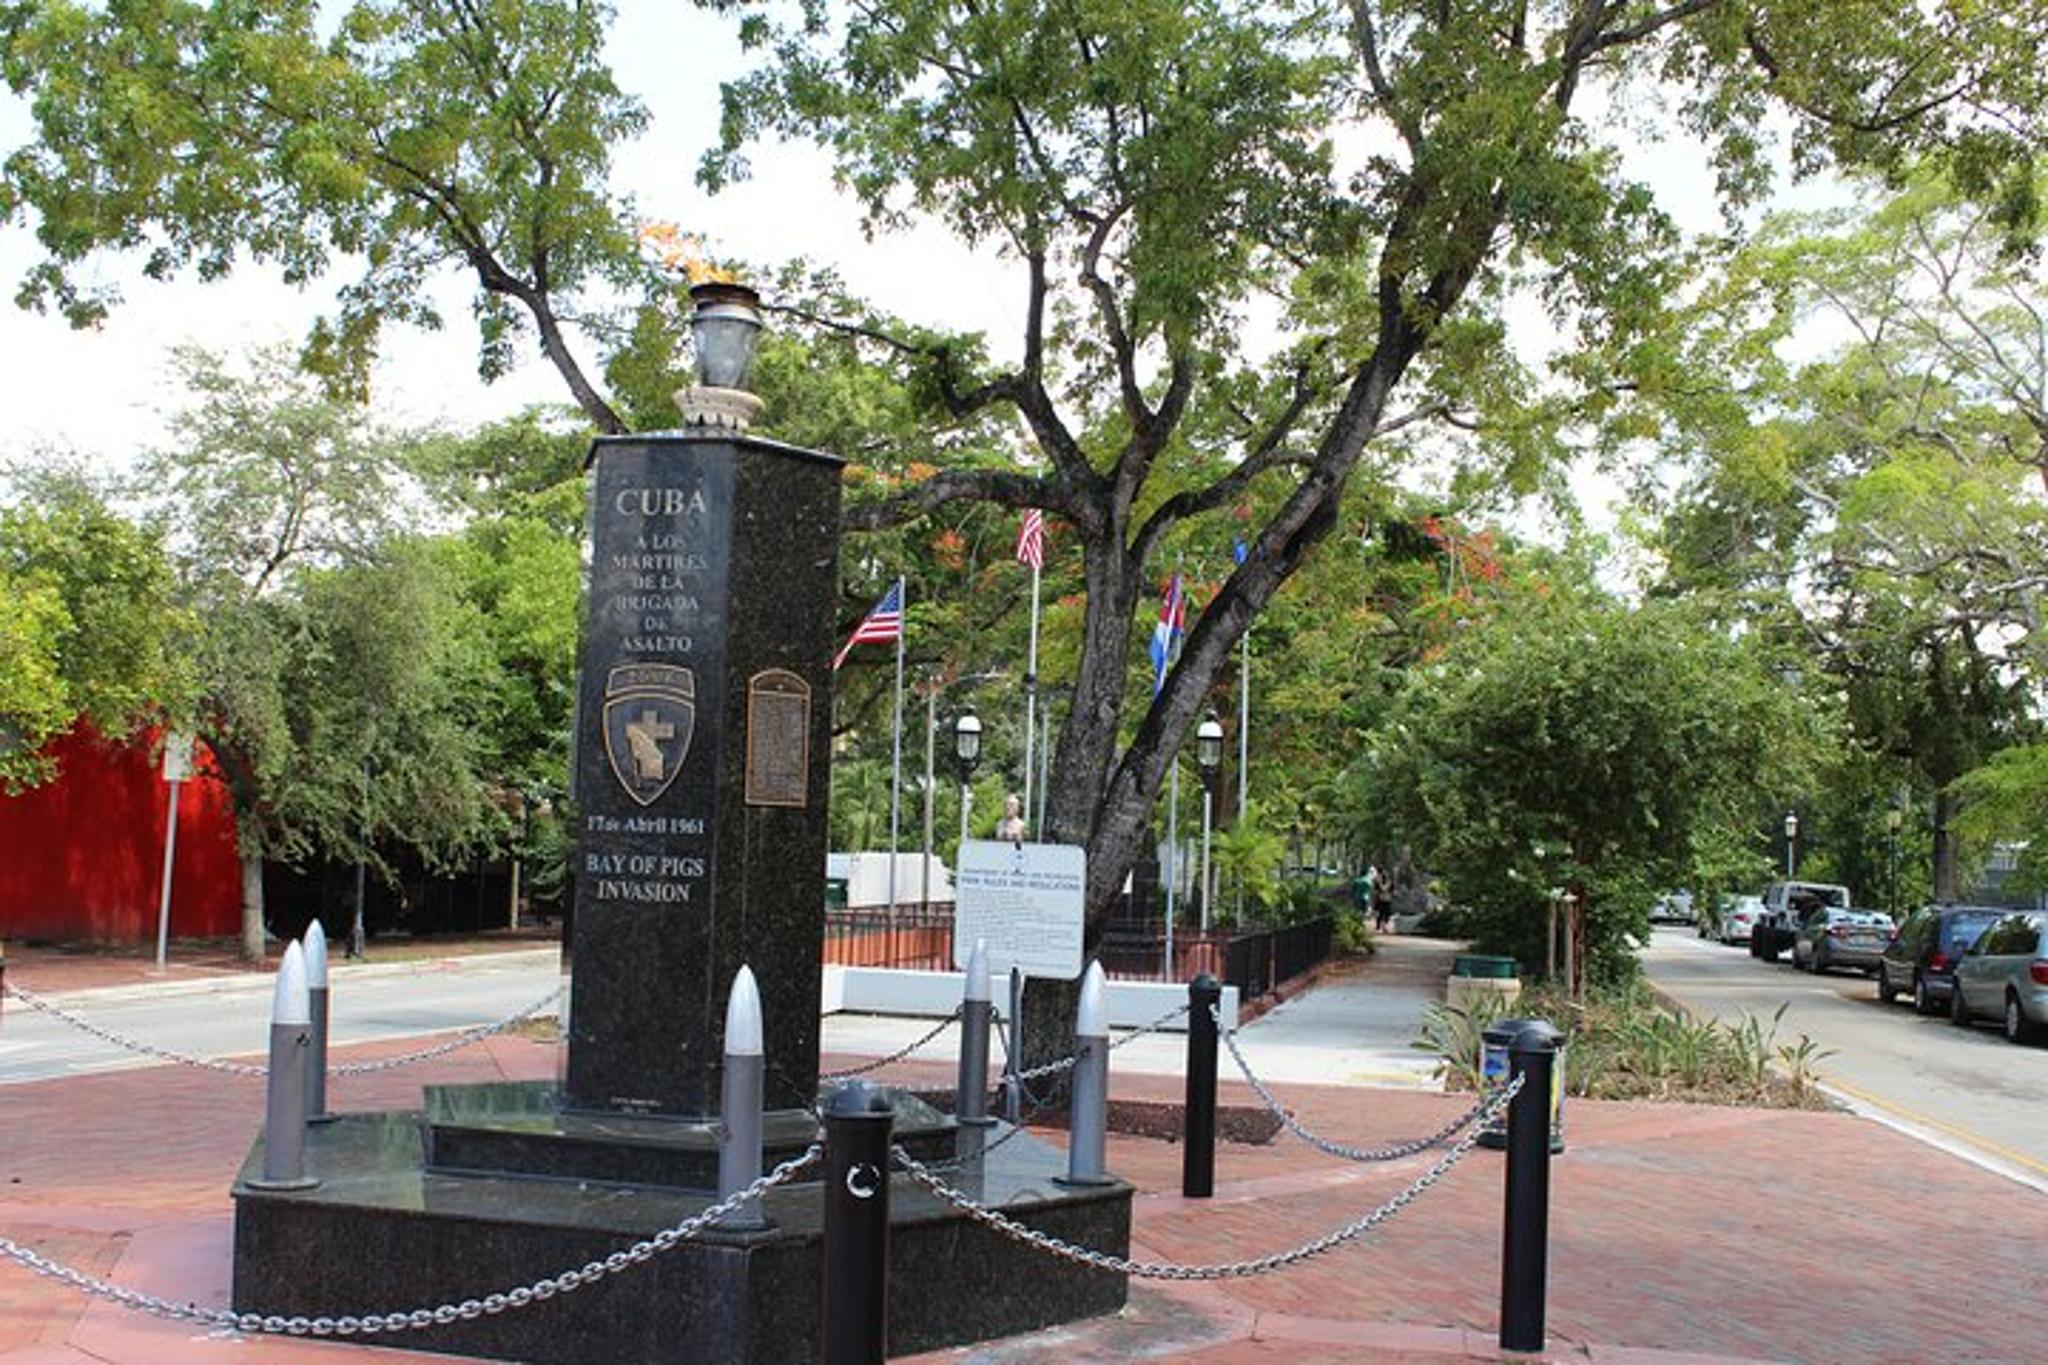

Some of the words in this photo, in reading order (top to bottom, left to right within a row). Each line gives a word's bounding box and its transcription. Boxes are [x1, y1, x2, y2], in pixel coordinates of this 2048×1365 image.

[636, 536, 647, 549] A
[652, 534, 685, 549] LOS
[633, 574, 655, 590] DE
[660, 574, 684, 590] LA
[623, 636, 693, 652] ASALTO
[624, 816, 666, 834] Abril
[670, 817, 704, 835] 1961
[586, 852, 626, 874] BAY
[629, 855, 657, 875] OF
[660, 857, 705, 877] PIGS
[597, 880, 691, 903] INVASION
